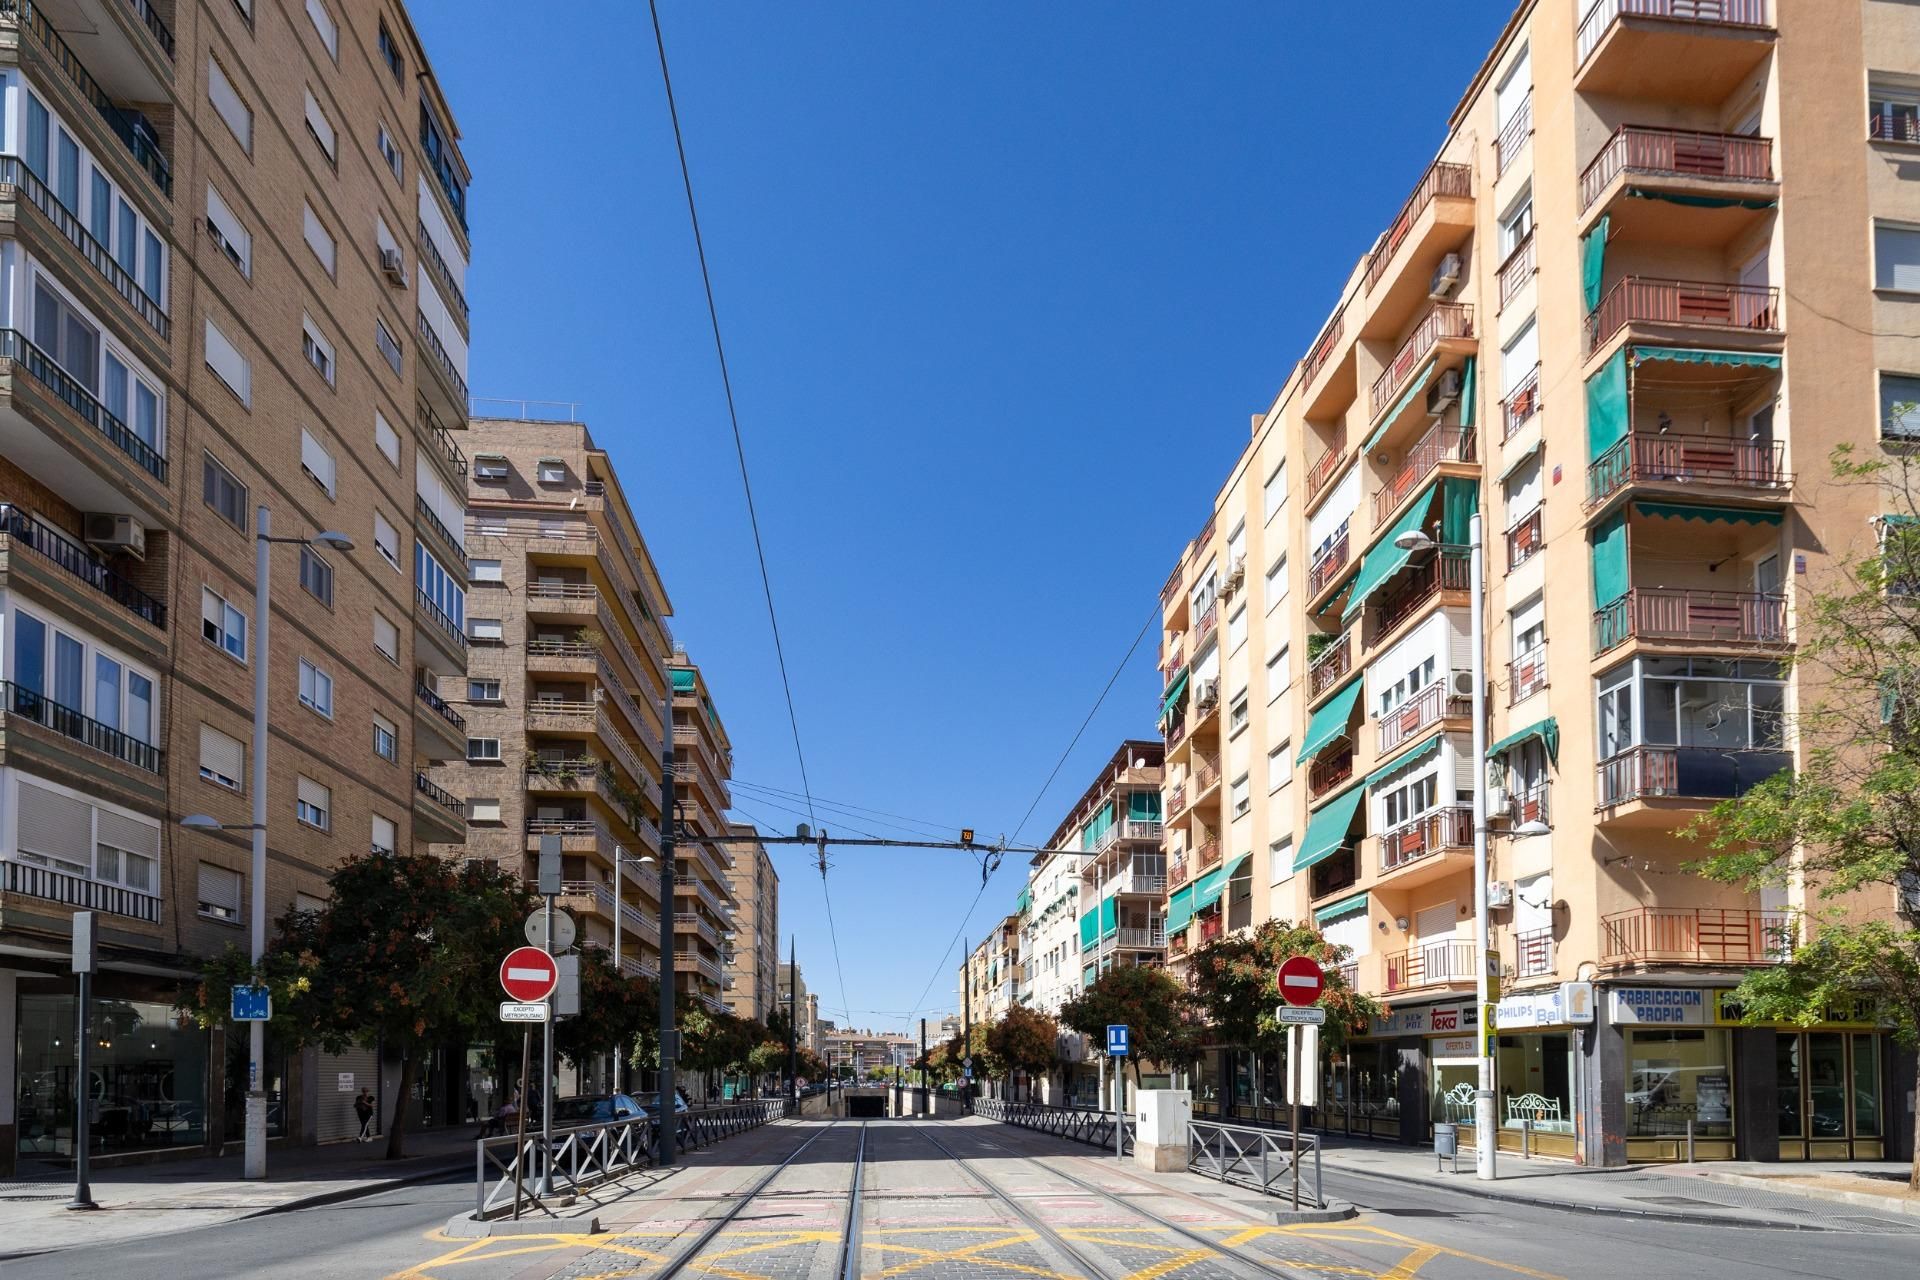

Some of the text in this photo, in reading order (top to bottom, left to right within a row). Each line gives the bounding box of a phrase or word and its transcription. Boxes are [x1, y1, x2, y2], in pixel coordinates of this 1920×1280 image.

[1618, 990, 1701, 1005] FABRICACION
[1498, 1005, 1533, 1019] PHILIPS
[1537, 1007, 1561, 1022] Bal
[1637, 1007, 1684, 1022] PROPIA
[1445, 1040, 1464, 1051] OFERTA
